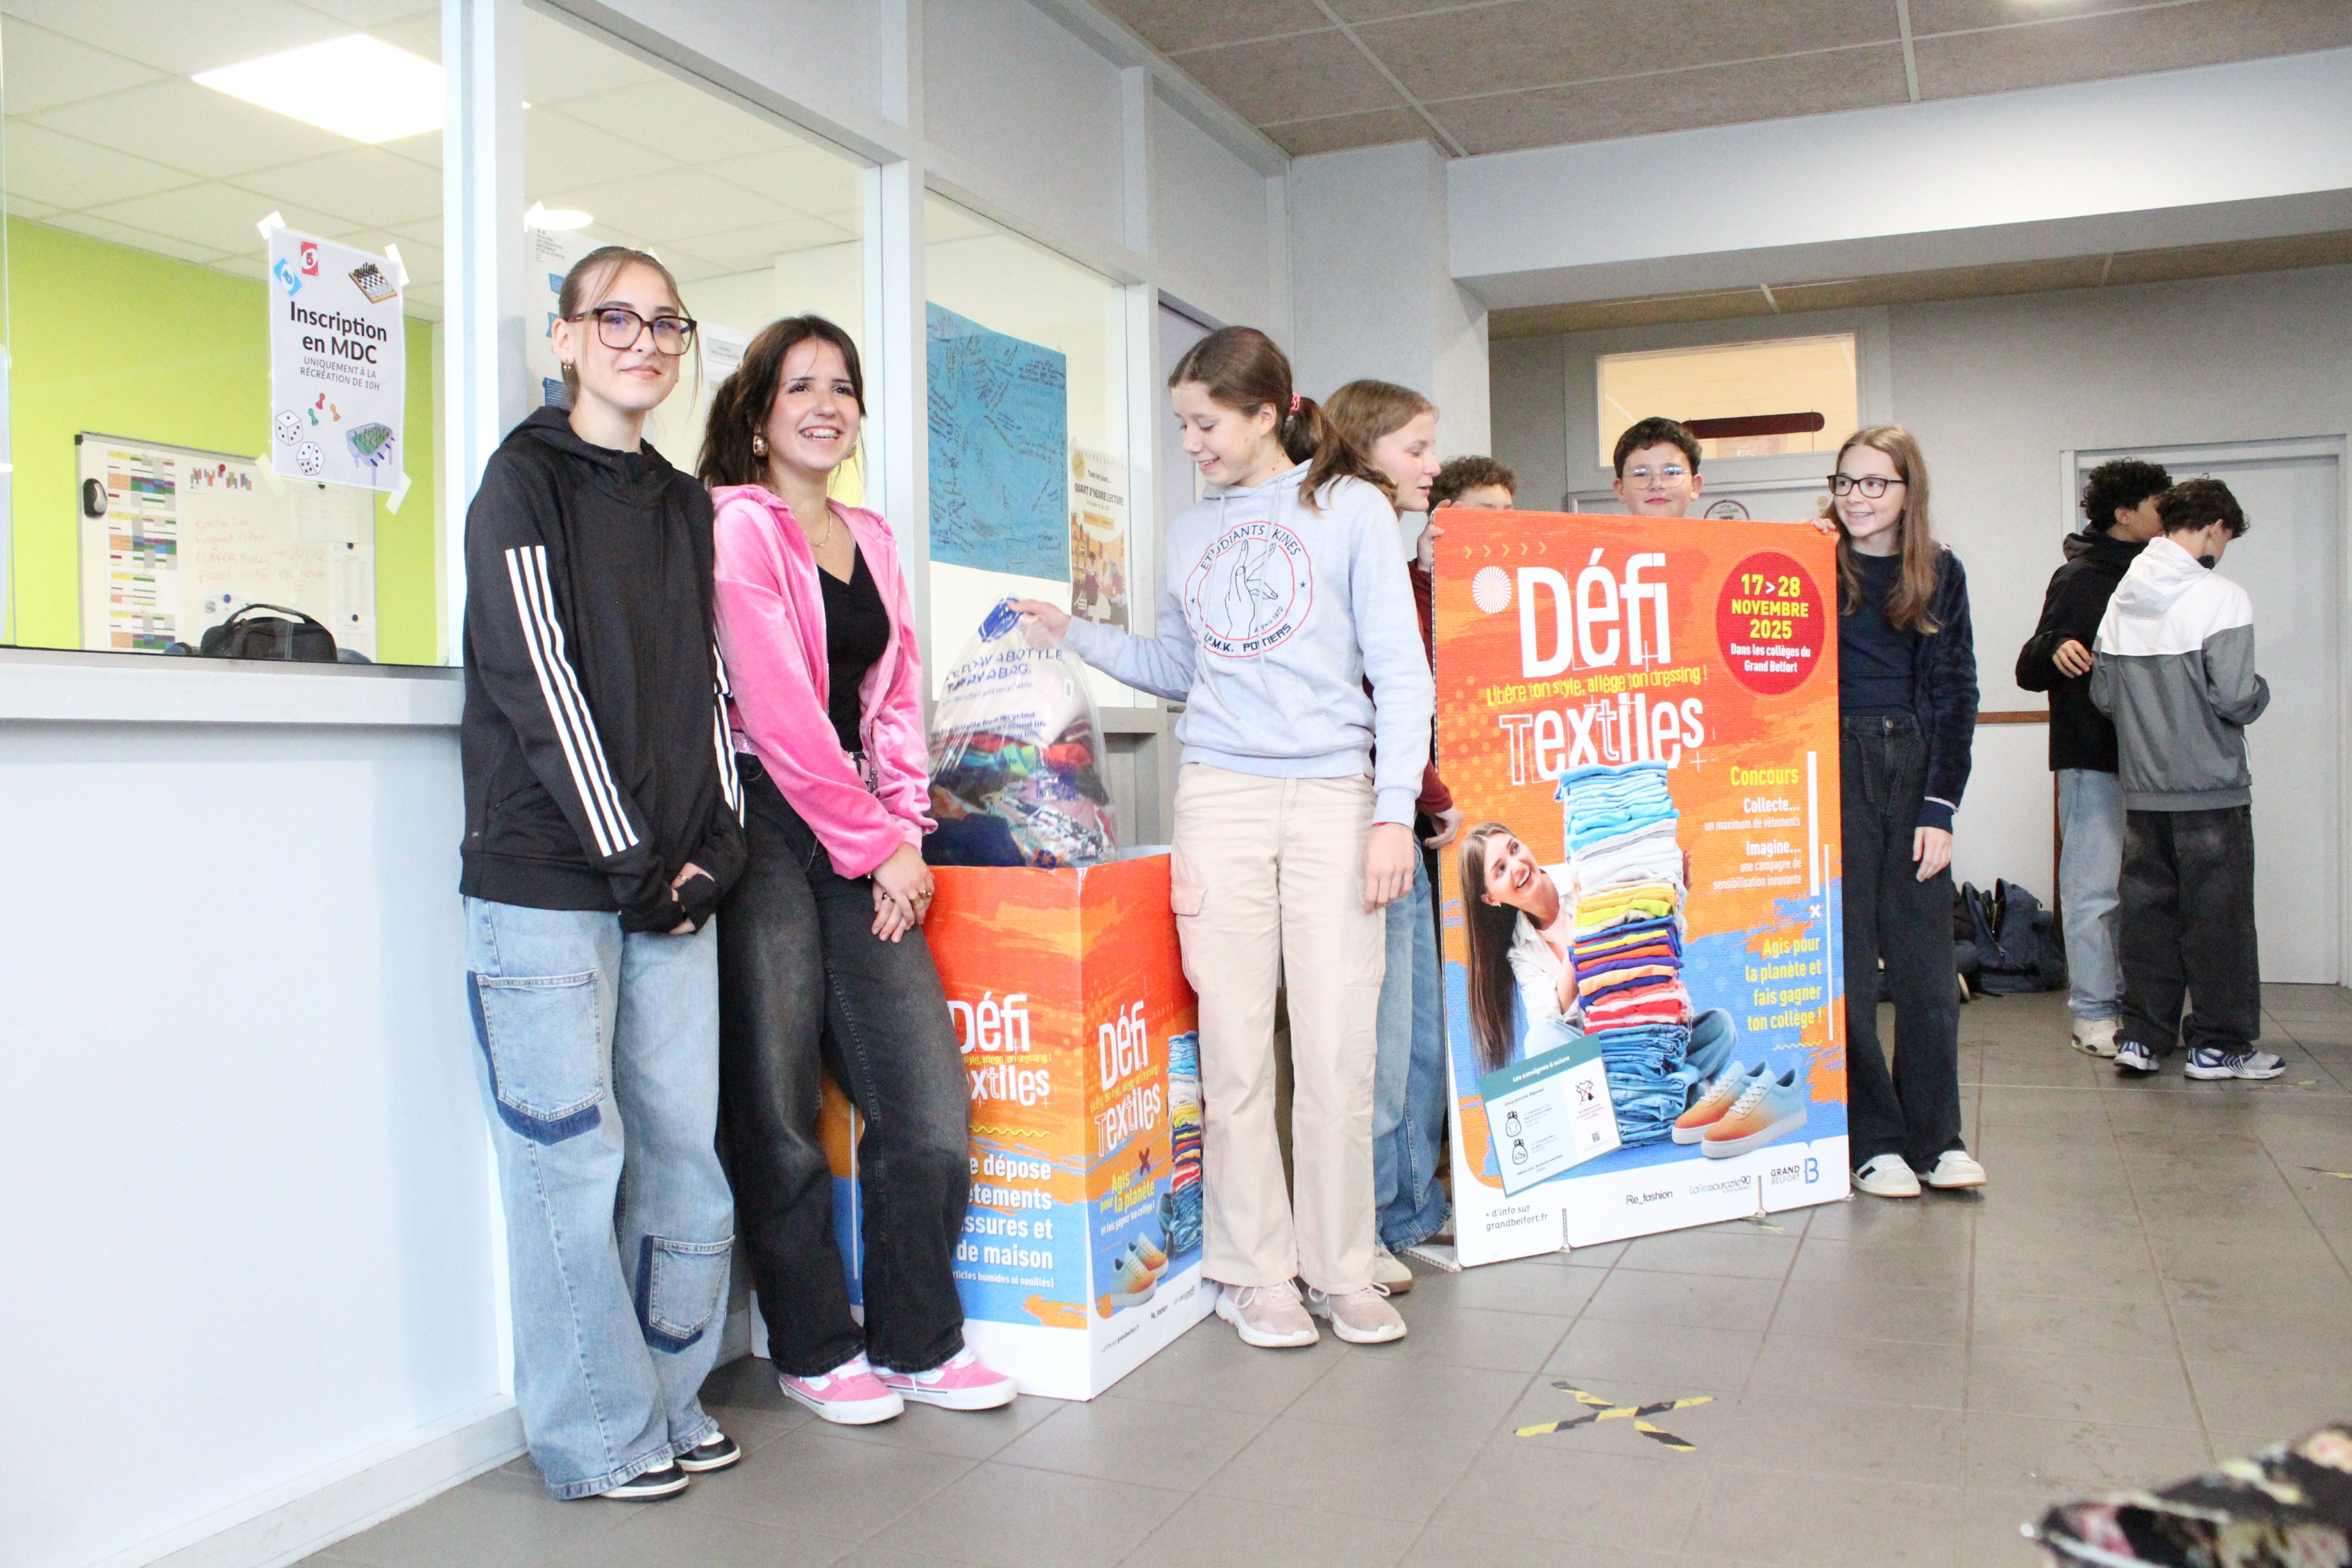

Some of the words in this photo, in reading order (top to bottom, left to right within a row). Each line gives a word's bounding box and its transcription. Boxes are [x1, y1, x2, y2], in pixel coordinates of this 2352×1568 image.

[306, 252, 314, 266] 5
[291, 301, 387, 341] Inscription
[302, 336, 325, 353] en
[331, 336, 377, 364] MDC
[301, 366, 350, 384] RÉCRÉATION
[353, 378, 362, 387] DE
[365, 381, 380, 390] 10H
[304, 357, 358, 375] UNIQUEMENT
[360, 366, 365, 376] À
[367, 370, 377, 379] LA
[1075, 483, 1089, 496] QUART
[1089, 487, 1106, 501] D'HEURE
[1107, 492, 1124, 506] LECTURE
[1201, 525, 1265, 570] ETUDIANTS
[1272, 529, 1301, 556] KINES
[1272, 606, 1283, 620] 1972
[1517, 548, 1671, 678] Défi
[1732, 599, 1809, 618] NOVEMBRE
[1243, 623, 1291, 652] POITIERS
[1750, 619, 1793, 639] 2025
[1730, 643, 1751, 656] Dans
[1752, 644, 1765, 656] les
[1766, 645, 1800, 659] collèges
[1801, 646, 1811, 658] du
[987, 669, 996, 680] A
[998, 663, 1031, 679] BAG.
[1744, 660, 1768, 672] Grand
[1770, 661, 1798, 673] Belfort
[1486, 684, 1526, 707] Libère
[1528, 682, 1551, 698] ton
[1553, 679, 1586, 698] style,
[1587, 674, 1626, 694] allège
[1627, 671, 1648, 688] ton
[1650, 666, 1700, 687] dressing
[1703, 665, 1707, 681] !
[1498, 692, 1704, 786] Textiles
[1730, 766, 1800, 787] Concours
[1743, 797, 1800, 814] Collecte...
[1704, 821, 1714, 831] un
[1716, 818, 1751, 831] maximum
[1753, 818, 1762, 829] de
[1764, 816, 1801, 827] vêtements
[1746, 839, 1801, 859] Imagine...
[1740, 861, 1753, 872] une
[1755, 859, 1791, 872] campagne
[1793, 857, 1801, 869] de
[1713, 877, 1766, 890] sensibilisation
[1767, 874, 1801, 886] innovante
[1763, 937, 1790, 958] Agis
[1793, 937, 1821, 957] pour
[1745, 965, 1758, 983] la
[1760, 961, 1806, 984] planète
[1809, 960, 1822, 975] et
[1754, 987, 1777, 1007] fais
[1780, 986, 1822, 1007] gagner
[947, 991, 1030, 1054] Défi
[1747, 1016, 1768, 1032] ton
[1770, 1009, 1815, 1029] collège
[1099, 1000, 1148, 1092] Défi
[1017, 1054, 1047, 1064] dressing
[1522, 1064, 1549, 1080] consignes
[1553, 1056, 1570, 1066] suivre
[966, 1064, 1050, 1106] xtiles
[1095, 1083, 1161, 1158] Textiles
[970, 1157, 978, 1174] e
[983, 1153, 1052, 1182] dépose
[1771, 1165, 1800, 1177] GRAND
[1112, 1169, 1130, 1195] Agis
[1771, 1174, 1800, 1185] BELFORT
[969, 1183, 1052, 1210] tements
[1100, 1197, 1113, 1215] pour
[1114, 1195, 1123, 1214] la
[1125, 1180, 1155, 1214] planète
[1626, 1190, 1673, 1206] Re_fashion
[1101, 1225, 1106, 1235] et
[1107, 1221, 1115, 1233] fais
[1115, 1215, 1130, 1231] gagner
[1138, 1203, 1152, 1217] collège
[1486, 1212, 1548, 1232] grandbelfort.fr
[1492, 1206, 1515, 1217] d'info
[962, 1215, 1028, 1238] ssures
[1033, 1219, 1053, 1240] et
[957, 1240, 979, 1262] de
[983, 1244, 1054, 1270] maison
[952, 1270, 977, 1280] rticles
[978, 1272, 1010, 1284] humides
[1011, 1275, 1019, 1284] ni
[1020, 1275, 1054, 1288] souillés)
